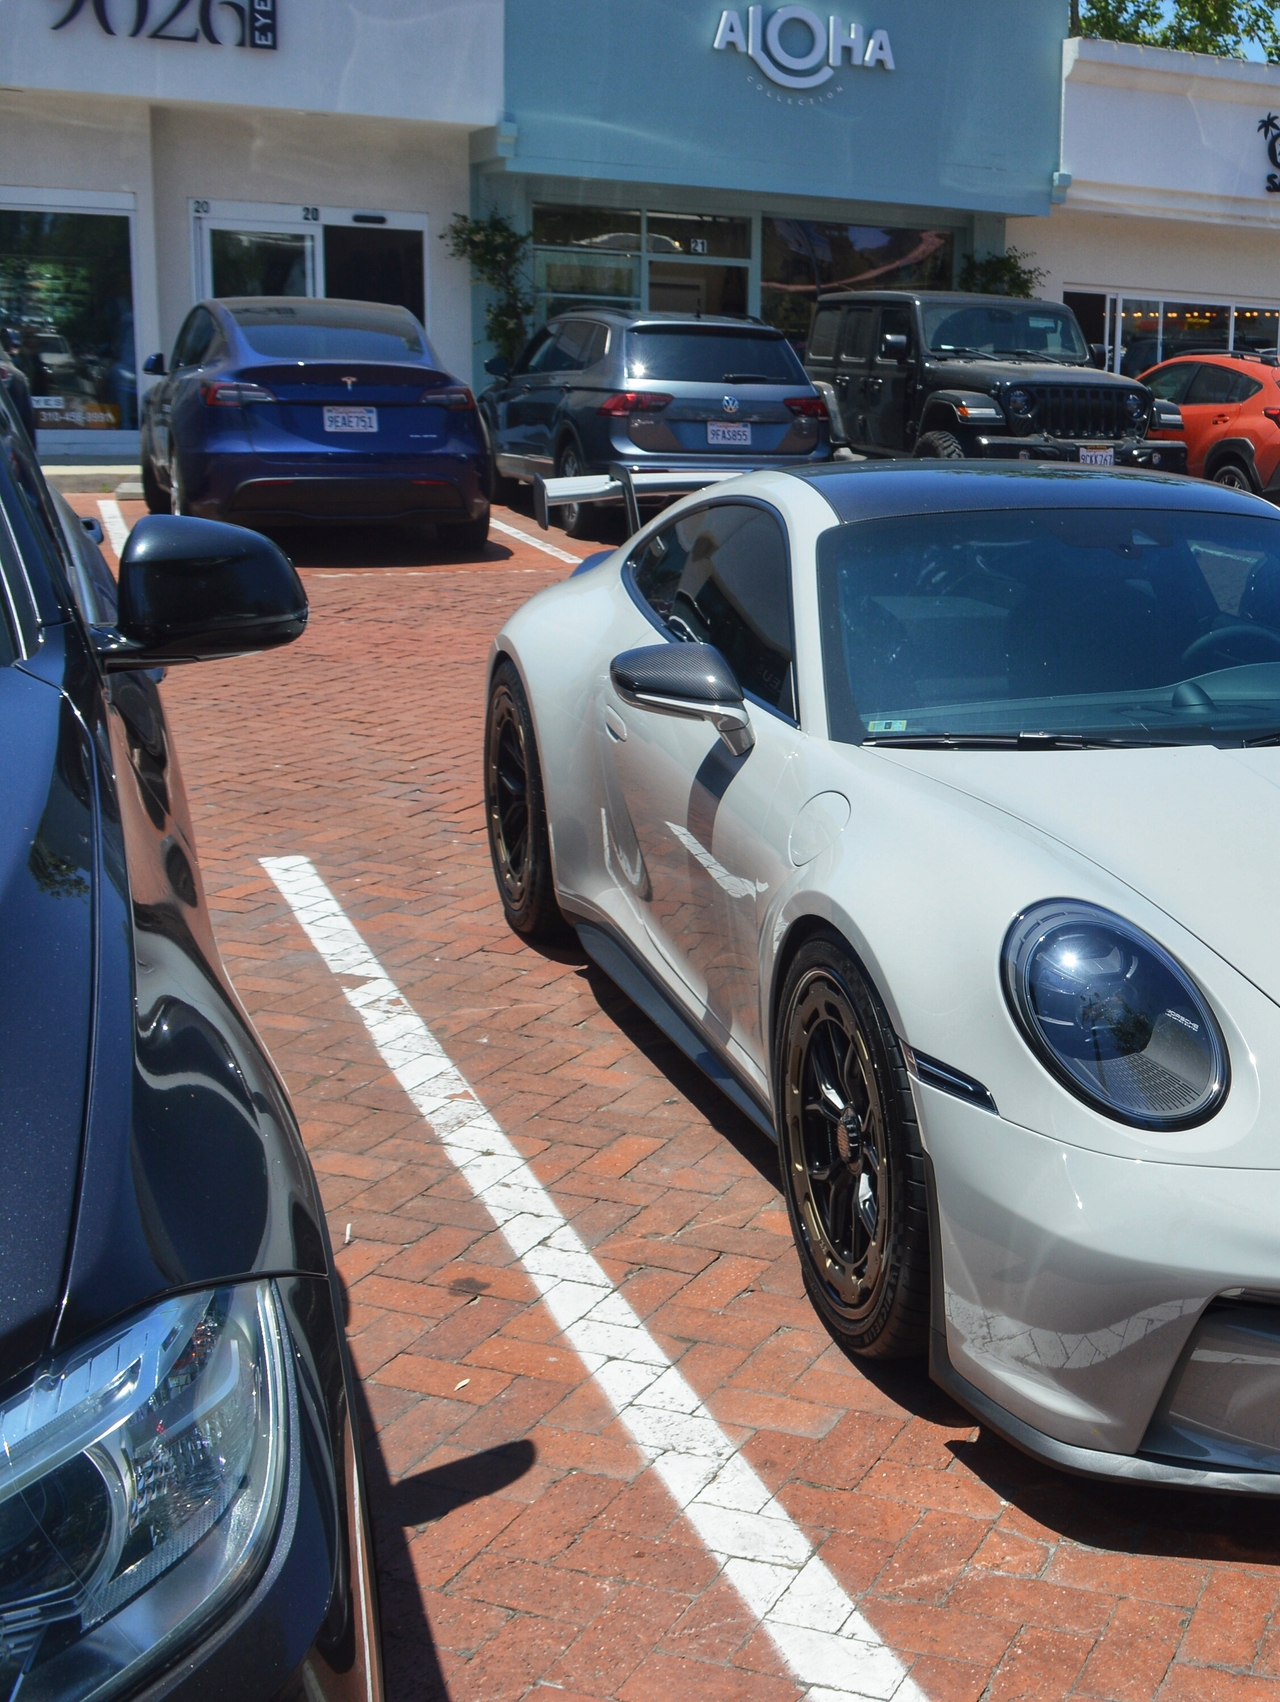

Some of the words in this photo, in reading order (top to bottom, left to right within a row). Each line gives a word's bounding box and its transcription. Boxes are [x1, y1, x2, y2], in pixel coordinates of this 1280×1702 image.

[713, 4, 895, 89] ALOHA
[747, 76, 843, 106] COLLECTION
[193, 200, 210, 214] 20
[302, 206, 320, 221] 20
[691, 239, 705, 252] 21
[327, 415, 374, 429] 9EAE751
[710, 429, 748, 442] 9FAS855
